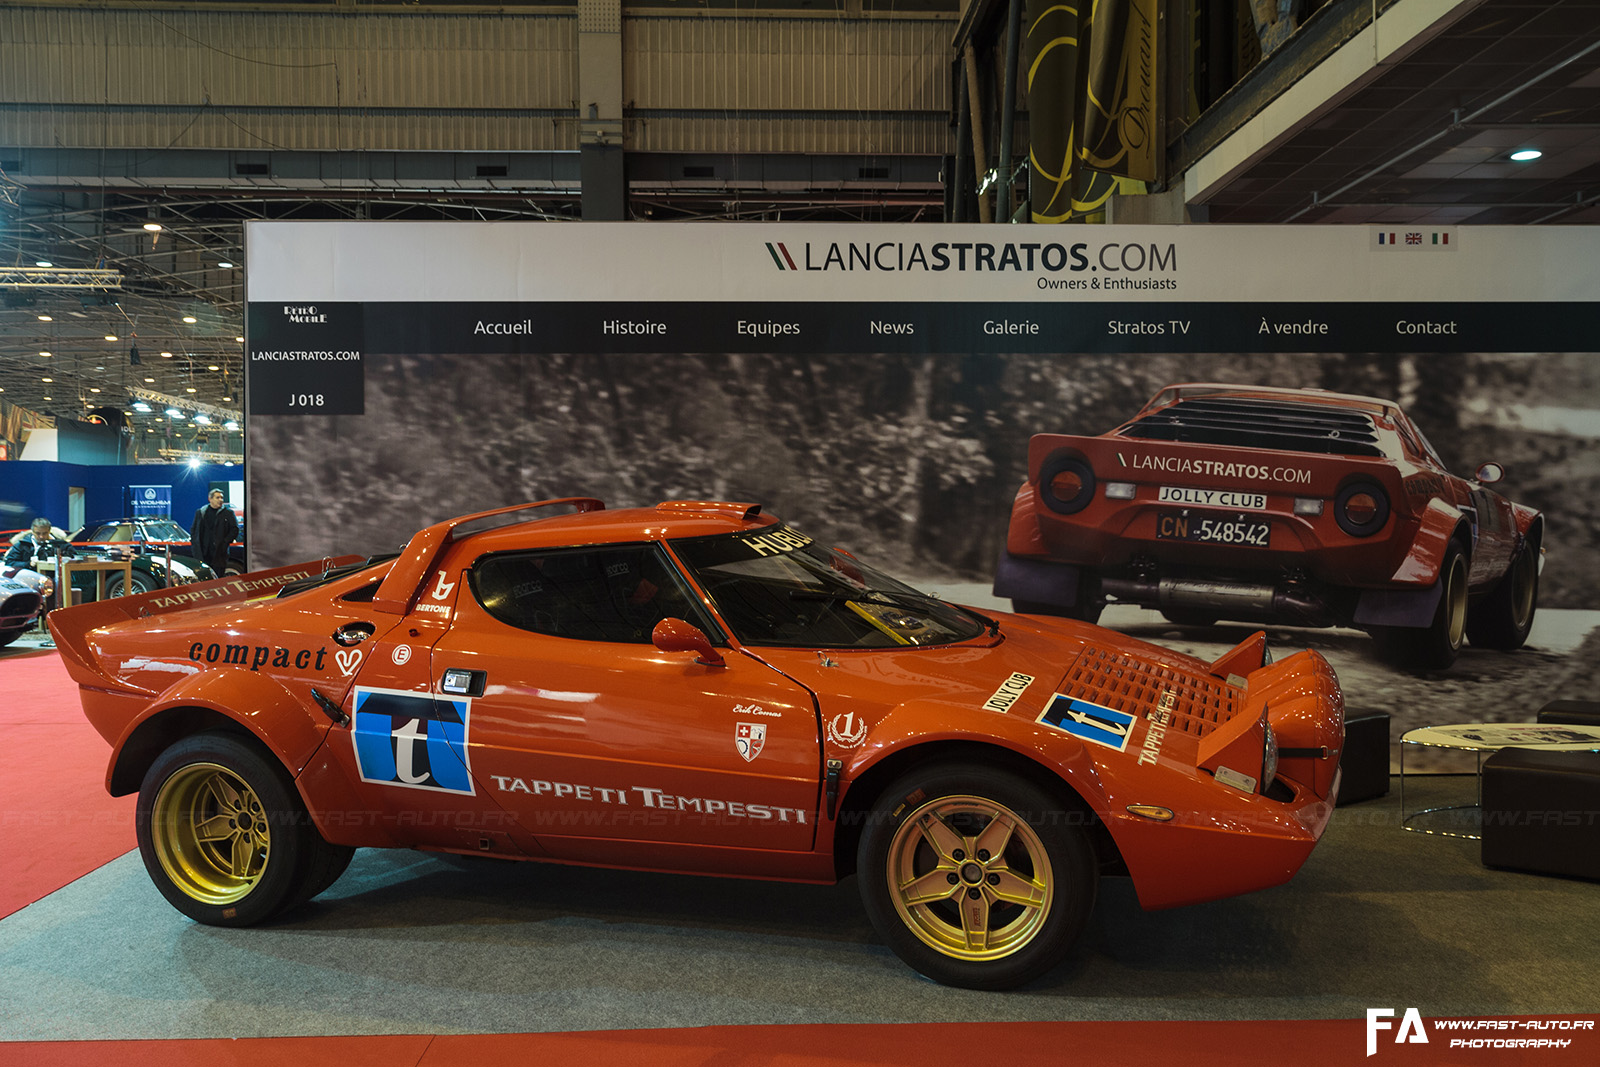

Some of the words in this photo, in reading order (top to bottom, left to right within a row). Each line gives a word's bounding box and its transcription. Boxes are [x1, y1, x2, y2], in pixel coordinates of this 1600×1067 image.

[805, 242, 1177, 272] LANCIASTRATOS.COM
[1037, 277, 1087, 290] Owners
[1090, 277, 1101, 290] &
[1103, 277, 1177, 290] Enthusiasts
[473, 319, 533, 335] Accueil
[603, 319, 667, 335] Histoire
[737, 319, 801, 338] Equipes
[870, 320, 915, 335] News
[983, 319, 1039, 335] Galerie
[1107, 320, 1165, 335] Stratos
[1169, 320, 1191, 335] TV
[1258, 316, 1271, 335] À
[1274, 319, 1330, 335] vendre
[1396, 320, 1458, 335] Contact
[251, 351, 361, 361] LANCIASTRATOS.COM
[288, 394, 296, 407] J
[298, 394, 325, 407] 018
[1132, 454, 1311, 485] LANCIASTRATOS.COM
[1161, 489, 1214, 504] JOLLY
[1219, 494, 1264, 509] CLUB
[1161, 516, 1189, 538] CN
[1200, 520, 1270, 547] 548542
[149, 586, 231, 609] TAPPETI
[227, 571, 311, 592] TEMPESTI
[190, 641, 328, 671] compact
[840, 711, 855, 738] 1
[1137, 717, 1168, 766] TAPPETI
[490, 775, 629, 806] TAPPETI
[632, 786, 808, 825] TEMPESTI
